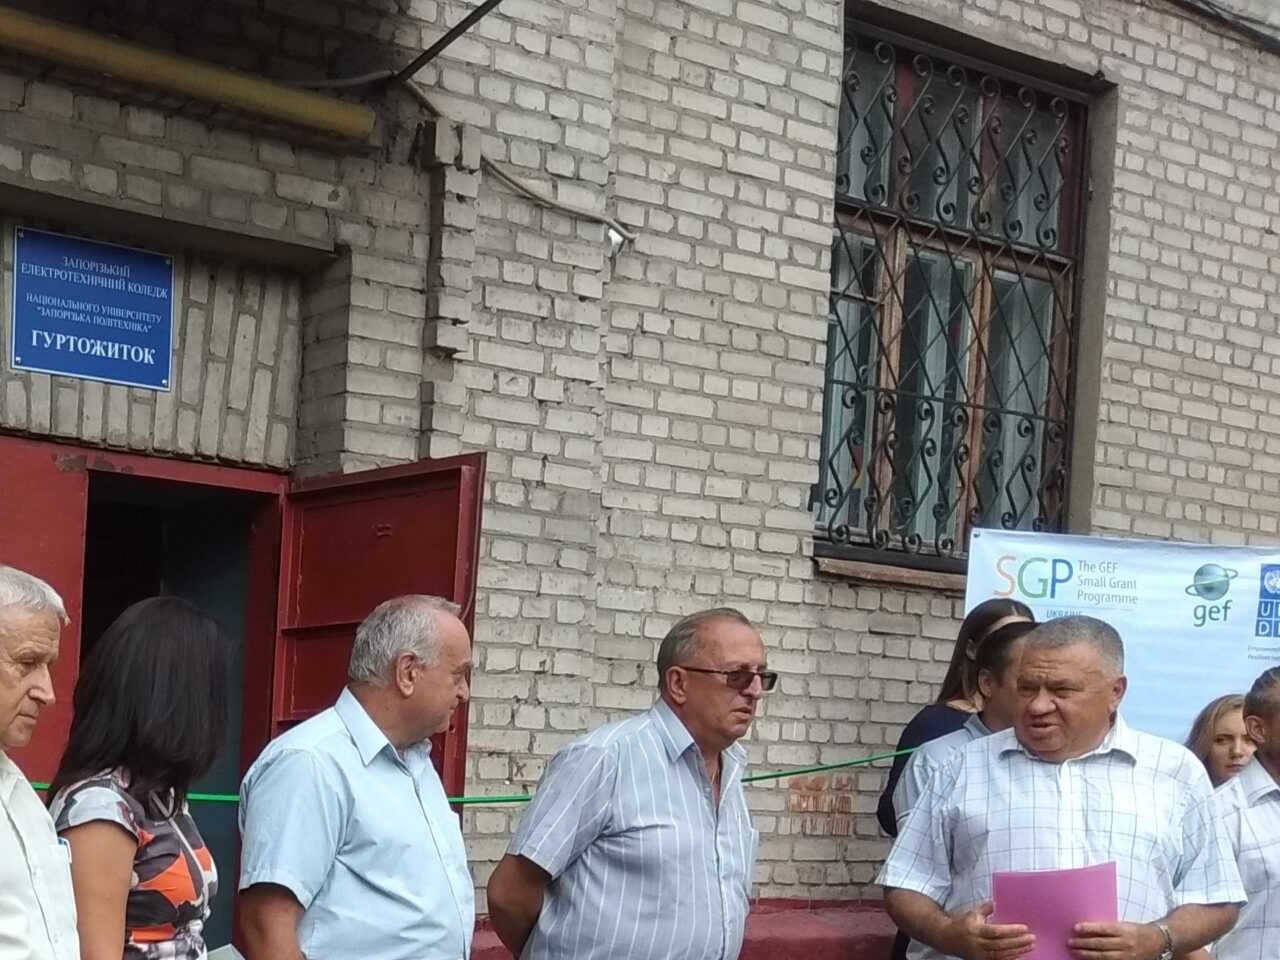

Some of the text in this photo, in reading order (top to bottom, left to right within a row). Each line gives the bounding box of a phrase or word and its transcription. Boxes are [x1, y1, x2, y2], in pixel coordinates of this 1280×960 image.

[63, 256, 130, 278] ЗАПОРІЗЬКИЙ
[21, 263, 168, 299] ЕЛЕКТРОТЕХНІЧНИЙ КОЛЕДЖ
[26, 292, 162, 324] НАЦІОНАЛЬНОГО УНІВЕРСИТЕТУ
[37, 306, 152, 333] "ЗАПОРІЗЬКА ПОЛІТЕХНІКА"
[31, 330, 155, 365] ГУРТОЖИТОК
[993, 555, 1074, 599] SGP
[1078, 560, 1119, 574] The GEF
[1077, 576, 1138, 590] Small Grant
[1077, 590, 1139, 606] Programme
[1193, 600, 1233, 627] gef
